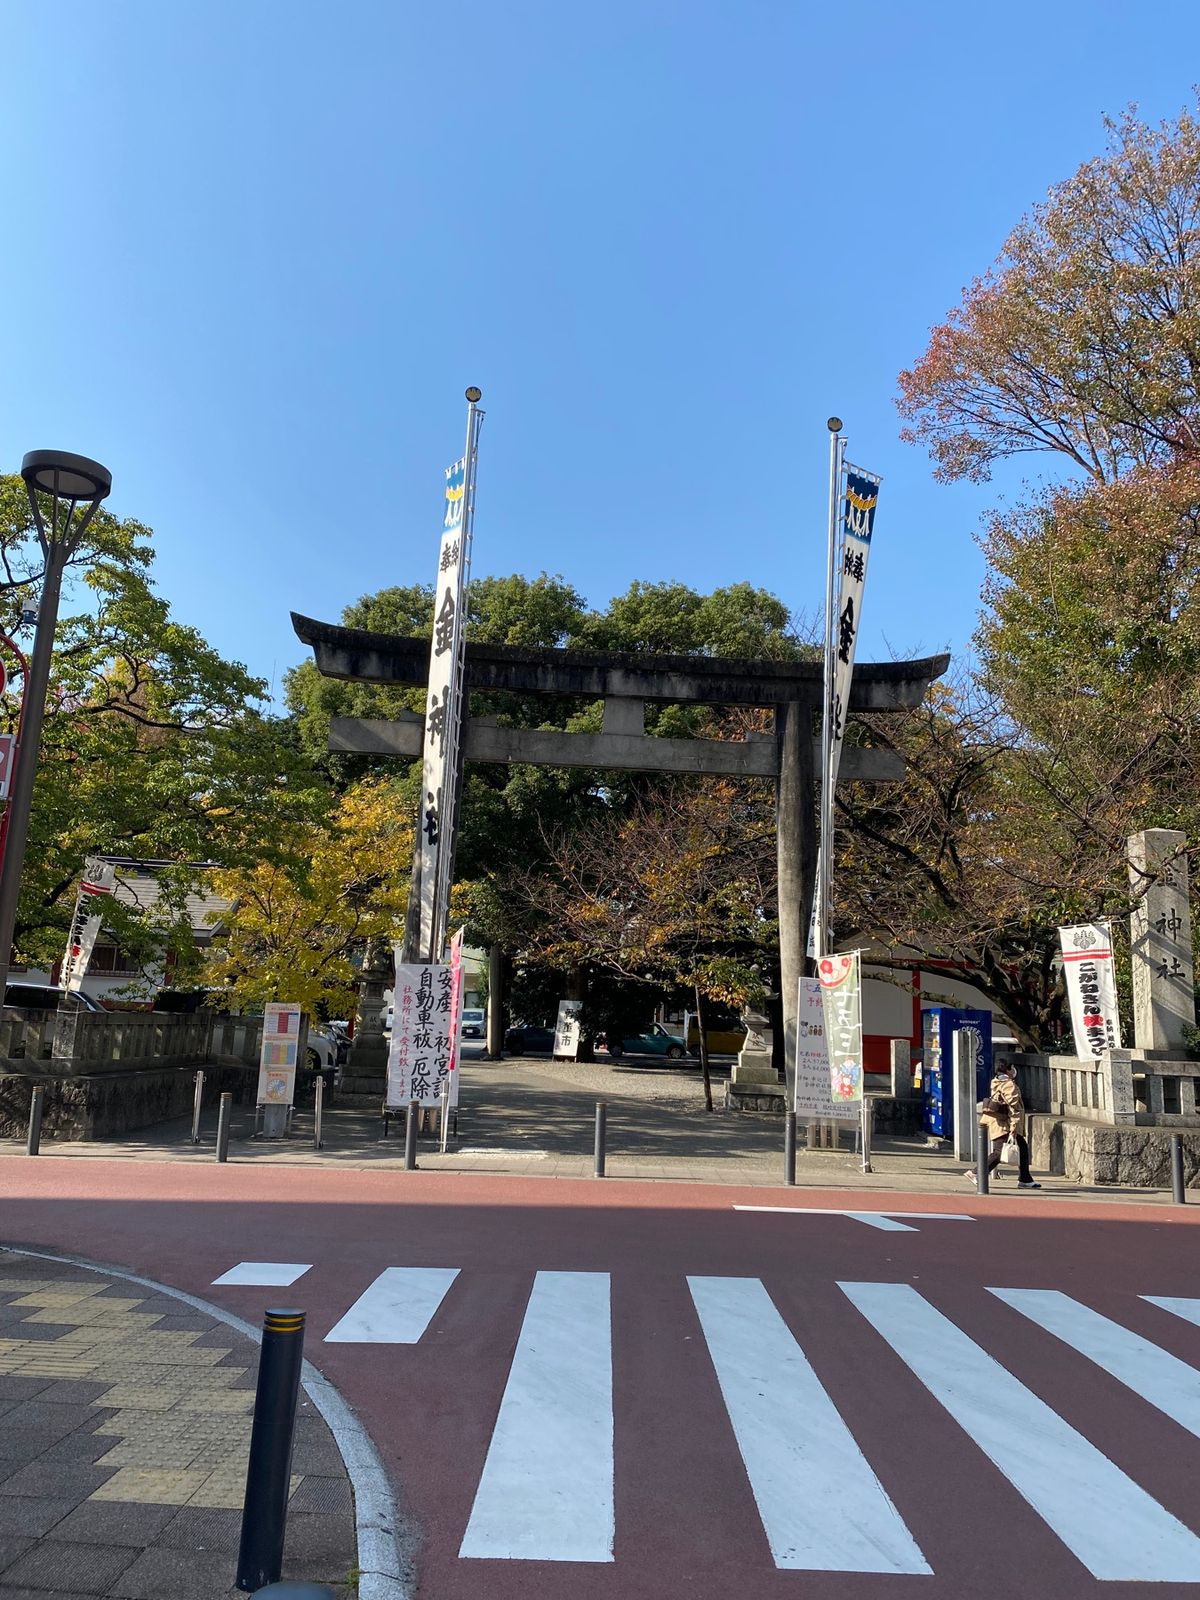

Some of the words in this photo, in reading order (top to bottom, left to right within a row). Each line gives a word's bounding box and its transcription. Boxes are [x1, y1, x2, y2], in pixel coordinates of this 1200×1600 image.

[398, 985, 413, 1098] 社務所にて受付致します
[410, 967, 435, 1100] 自動車祓・厄除
[958, 1026, 981, 1036] OFFEE
[1078, 961, 1107, 1056] こがねさん秋まつり
